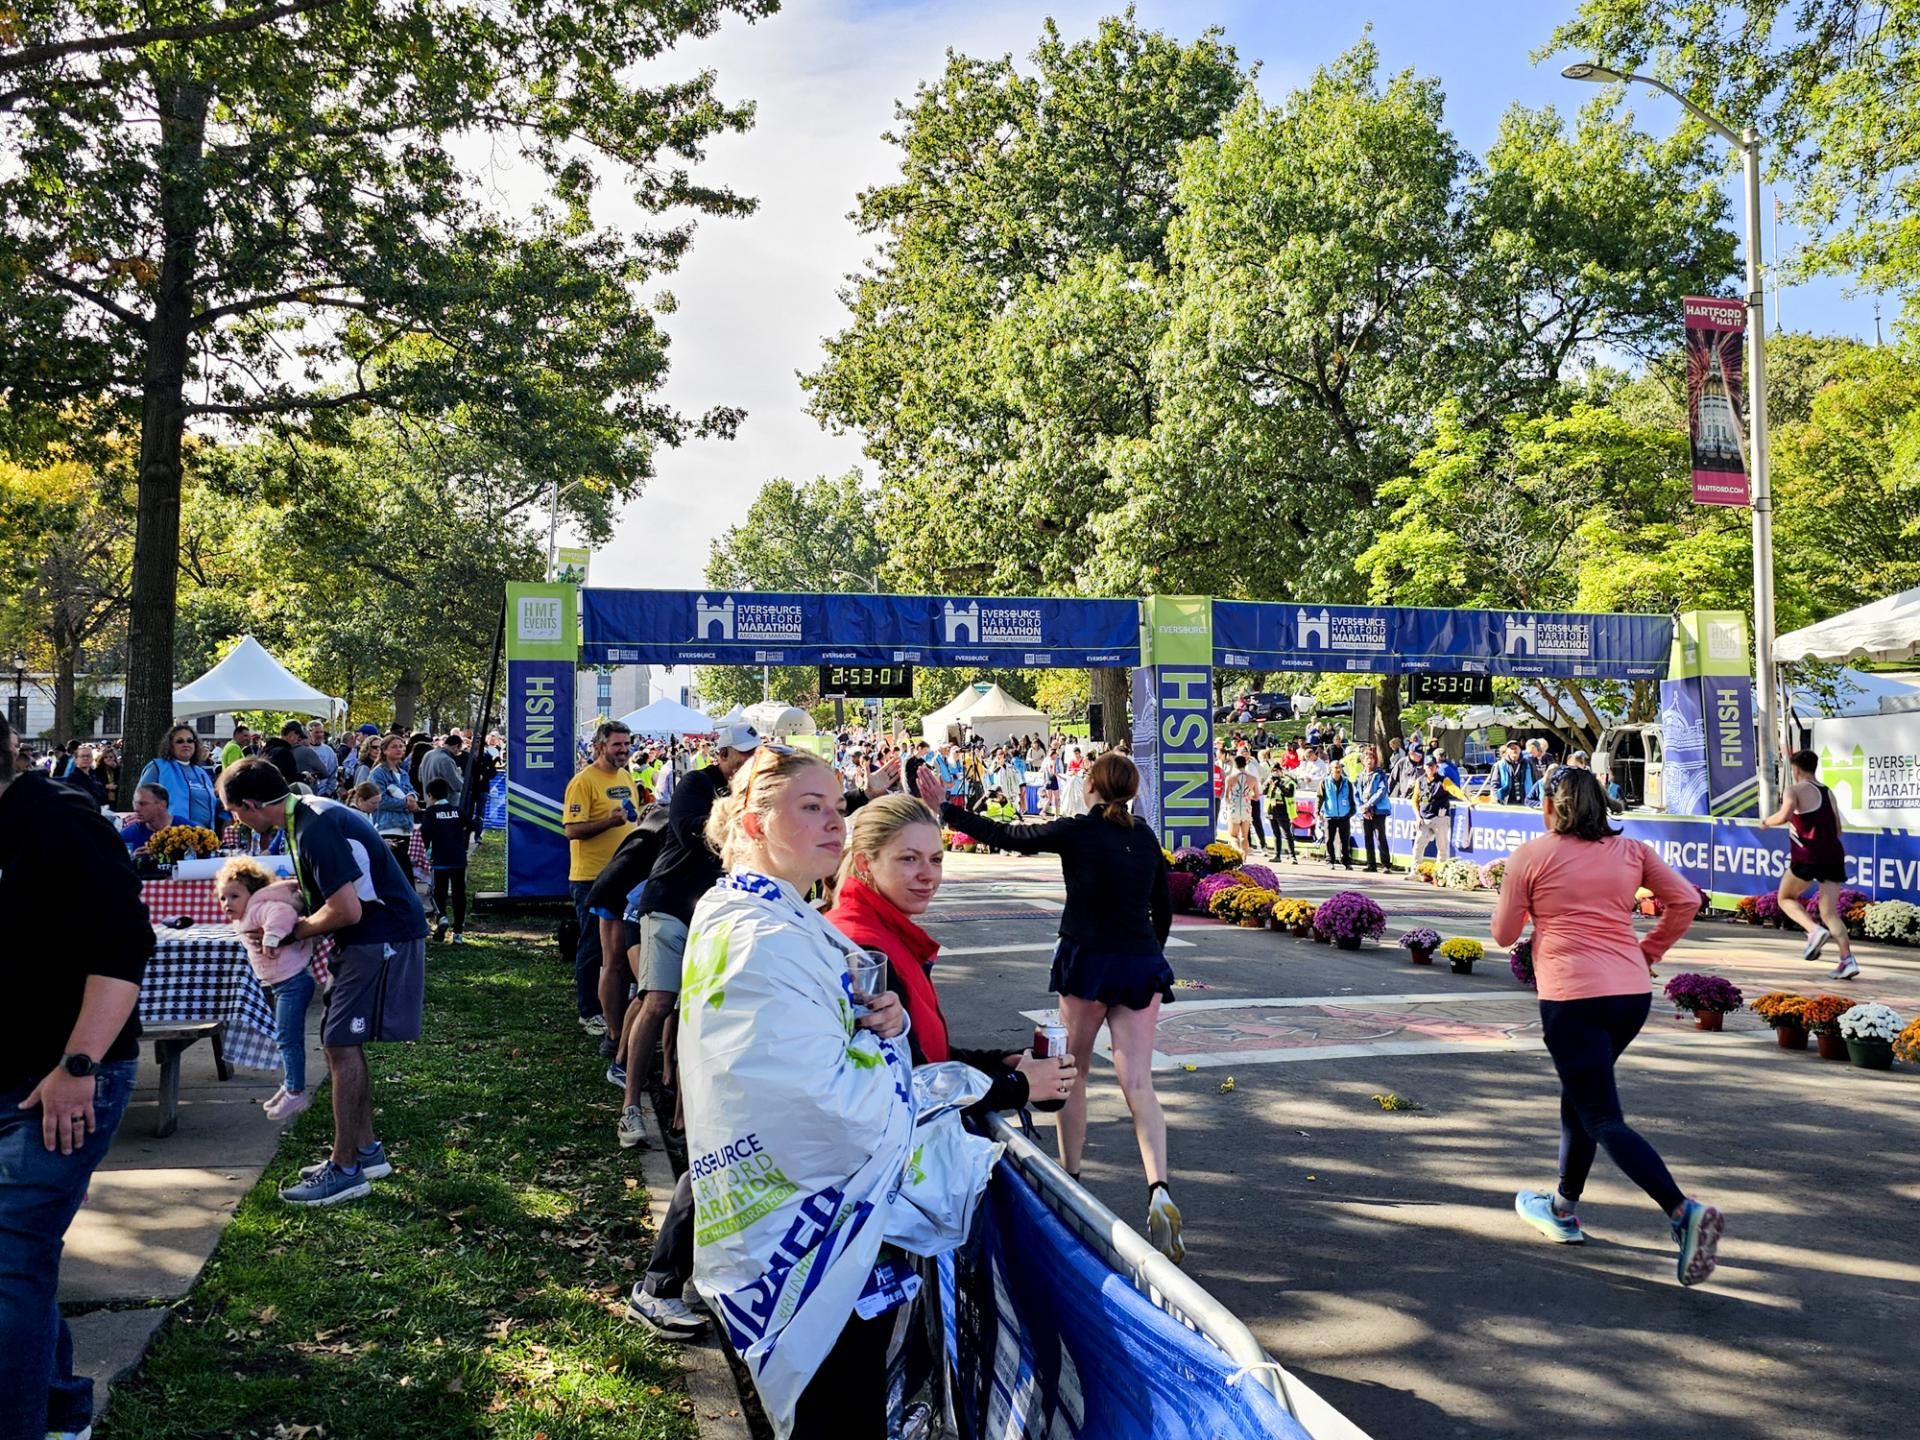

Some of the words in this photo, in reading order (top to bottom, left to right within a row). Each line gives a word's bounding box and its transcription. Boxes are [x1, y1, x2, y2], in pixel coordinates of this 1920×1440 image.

[1686, 305, 1742, 319] HARTFORD
[1716, 317, 1733, 326] HAS
[1734, 319, 1742, 327] IT
[1697, 484, 1744, 494] HARTFORD.COM
[524, 602, 558, 617] HMF
[737, 605, 802, 615] EVERSOURCE
[981, 609, 1040, 618] EVERSOURCE
[524, 617, 557, 629] EVENTS
[738, 614, 802, 624] HARTFORD
[982, 618, 1041, 627] HARTFORD
[1331, 617, 1386, 627] EVERSOURCE
[738, 623, 802, 632] MARATHON
[982, 627, 1041, 636] MARATHON
[1158, 625, 1209, 634] EVERSOURCE
[1331, 626, 1386, 634] HARTFORD
[1537, 623, 1589, 633] EVERSOURCE
[1331, 633, 1386, 643] MARATHON
[1537, 632, 1589, 641] HARTFORD
[1537, 640, 1589, 649] MARATHON
[525, 677, 555, 769] FINISH
[1716, 689, 1743, 767] FINISH
